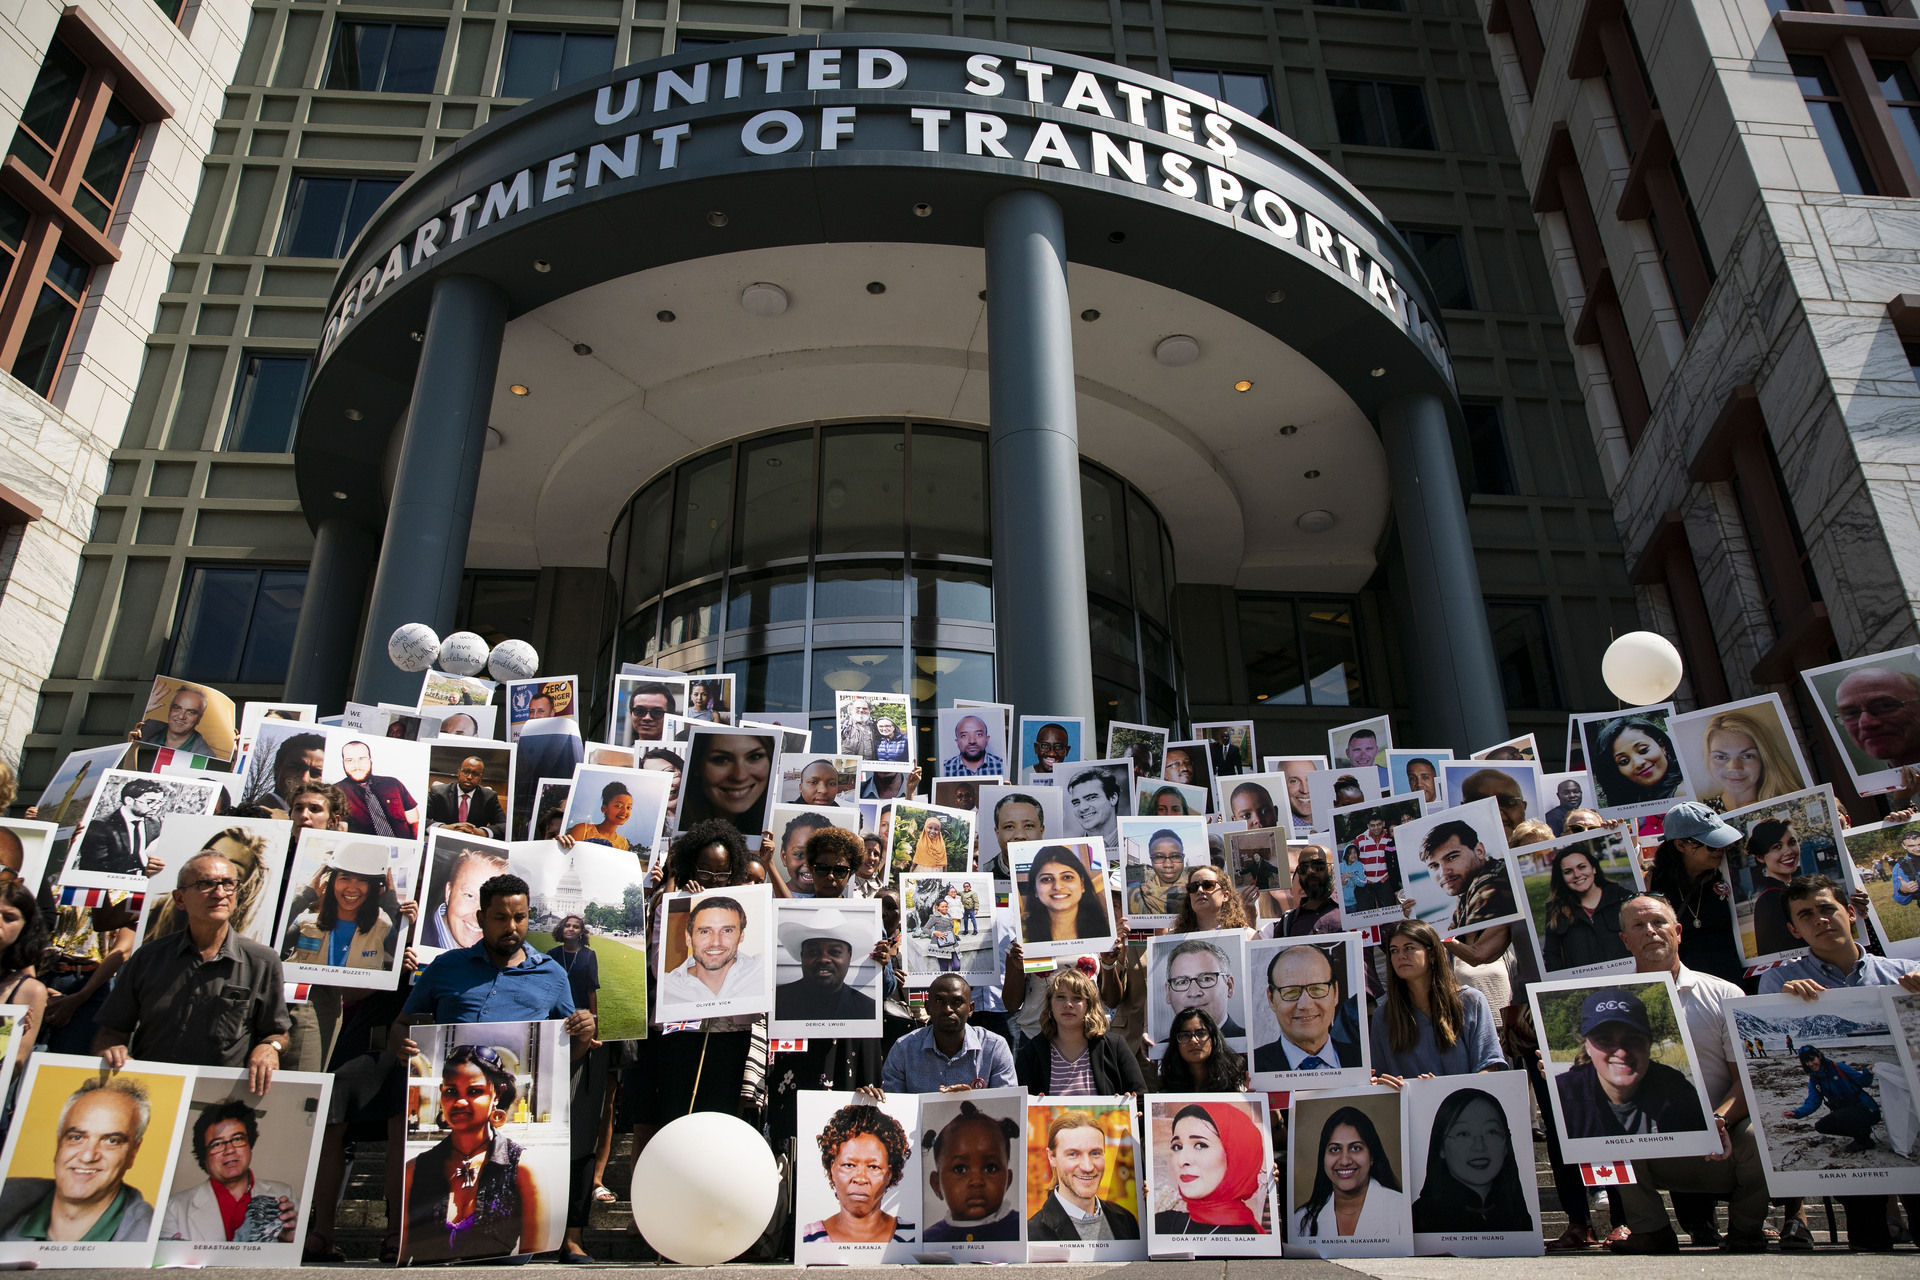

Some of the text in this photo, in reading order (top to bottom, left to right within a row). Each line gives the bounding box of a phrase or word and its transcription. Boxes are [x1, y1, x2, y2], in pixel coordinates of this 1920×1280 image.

[594, 48, 1238, 159] UNITED STATES
[319, 123, 692, 363] DEPARTMENT
[740, 106, 858, 156] OF
[450, 641, 472, 651] have
[442, 653, 482, 665] celebrated
[545, 682, 568, 695] ZERO
[552, 692, 571, 701] NGER
[350, 710, 361, 718] WE
[347, 721, 363, 729] WILL
[1571, 960, 1633, 975] STÉPHANIE LACROIX
[1638, 1135, 1674, 1143] REHHORN
